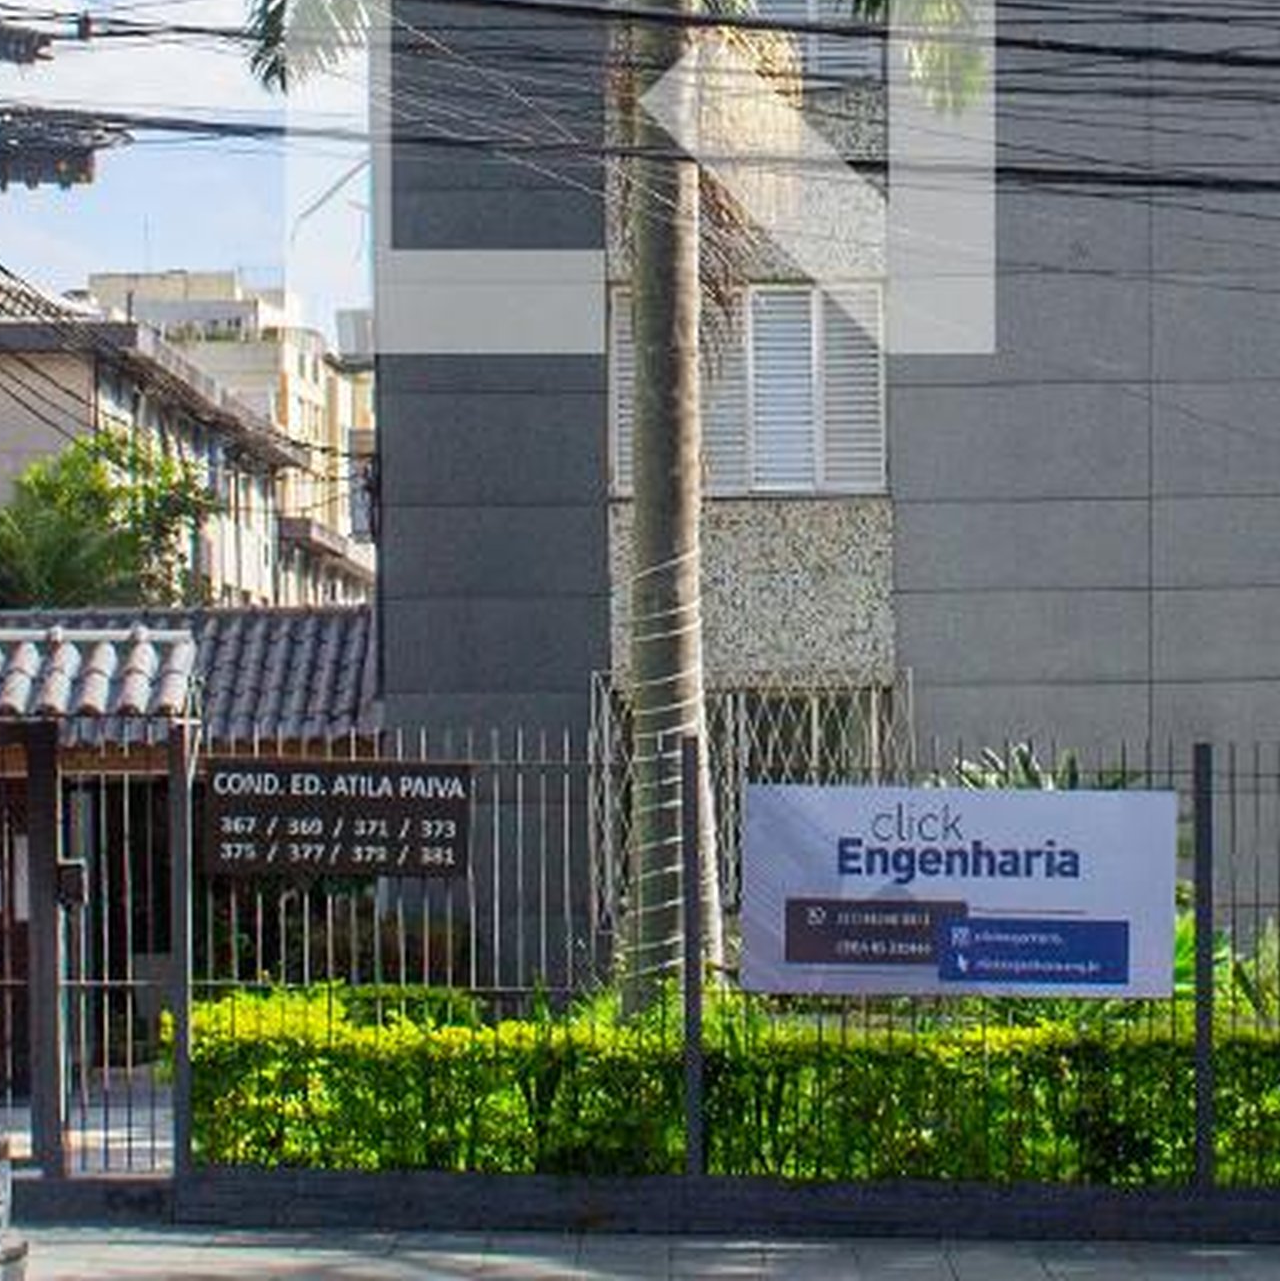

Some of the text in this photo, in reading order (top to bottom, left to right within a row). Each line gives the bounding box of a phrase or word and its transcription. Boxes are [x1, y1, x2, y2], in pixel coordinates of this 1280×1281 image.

[213, 772, 465, 799] COND. ED. ATILA PAIVA
[421, 820, 456, 838] 373
[871, 802, 964, 842] click
[837, 837, 1081, 885] Engenharia
